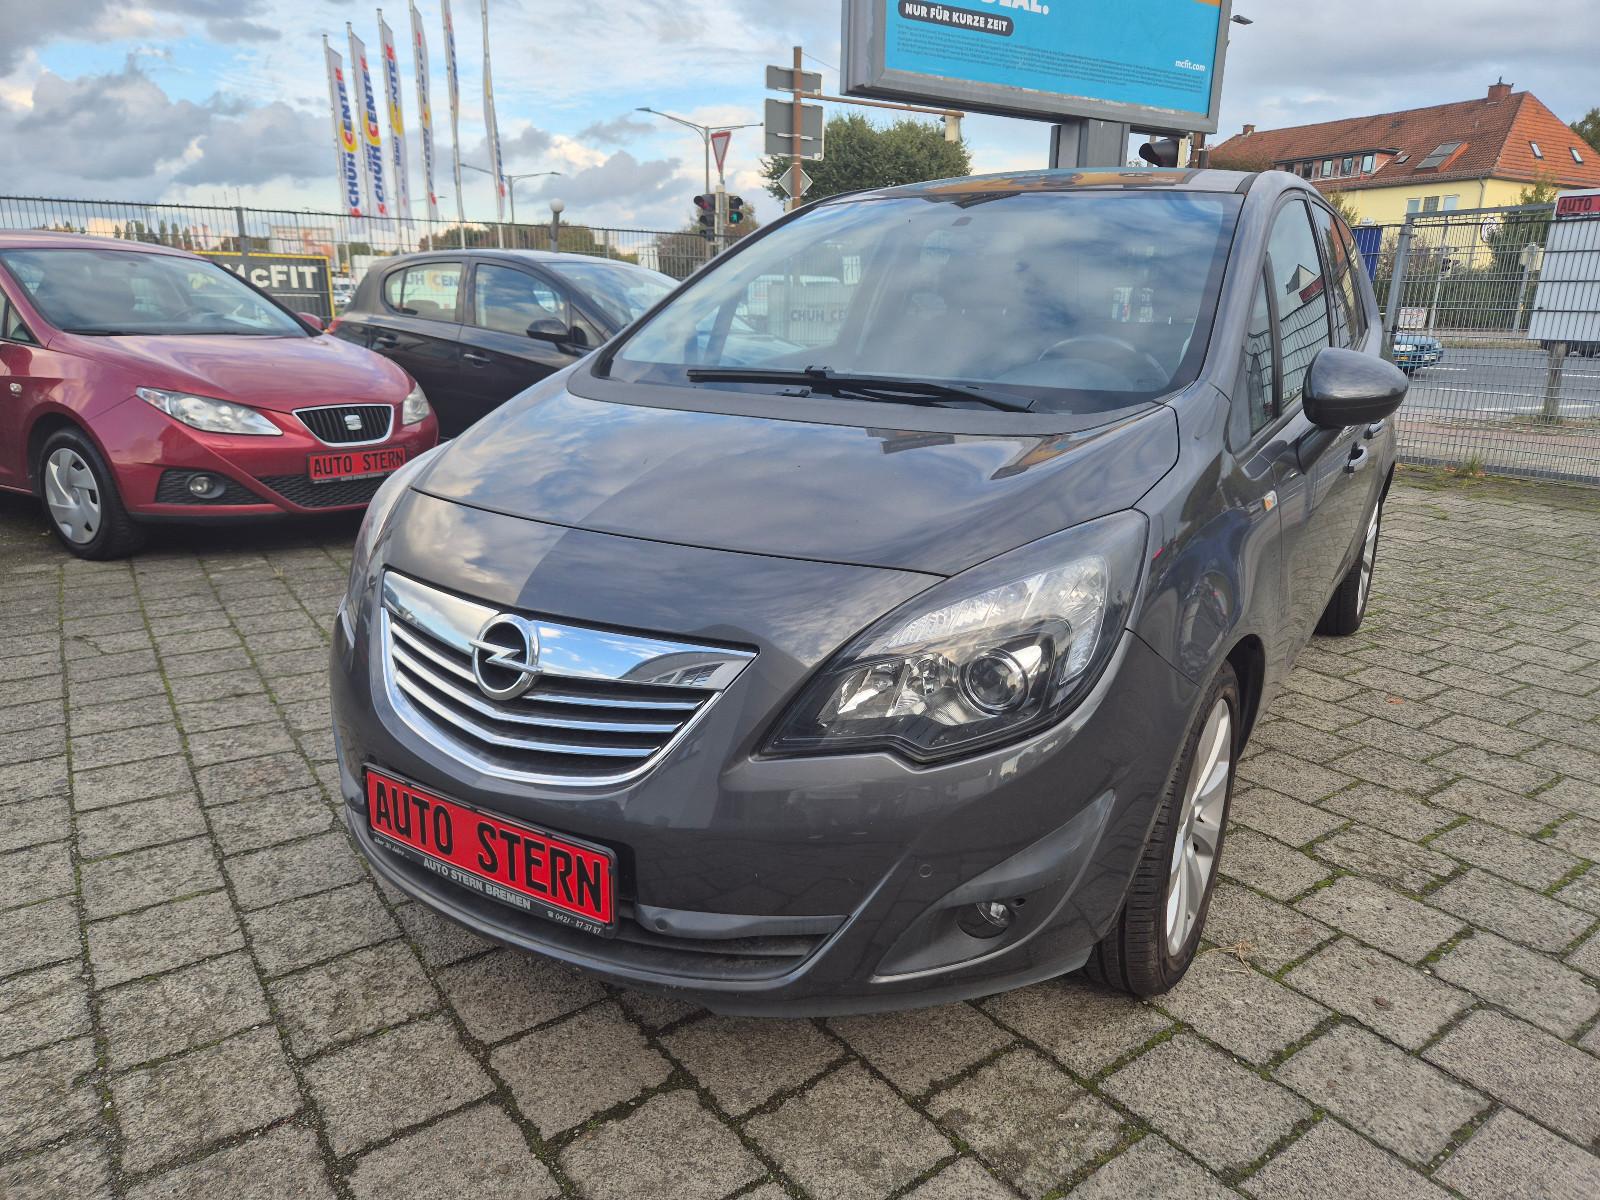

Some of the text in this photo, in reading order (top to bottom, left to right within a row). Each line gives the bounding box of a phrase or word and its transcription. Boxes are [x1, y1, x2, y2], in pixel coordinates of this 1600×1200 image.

[905, 3, 1008, 32] NUR FÜR KURZE ZEIT
[1175, 59, 1206, 72] mcfit.com
[313, 450, 403, 477] AUTO STERN
[375, 780, 602, 914] AUTO STERN
[424, 857, 531, 911] AUTO STERN BREMEN
